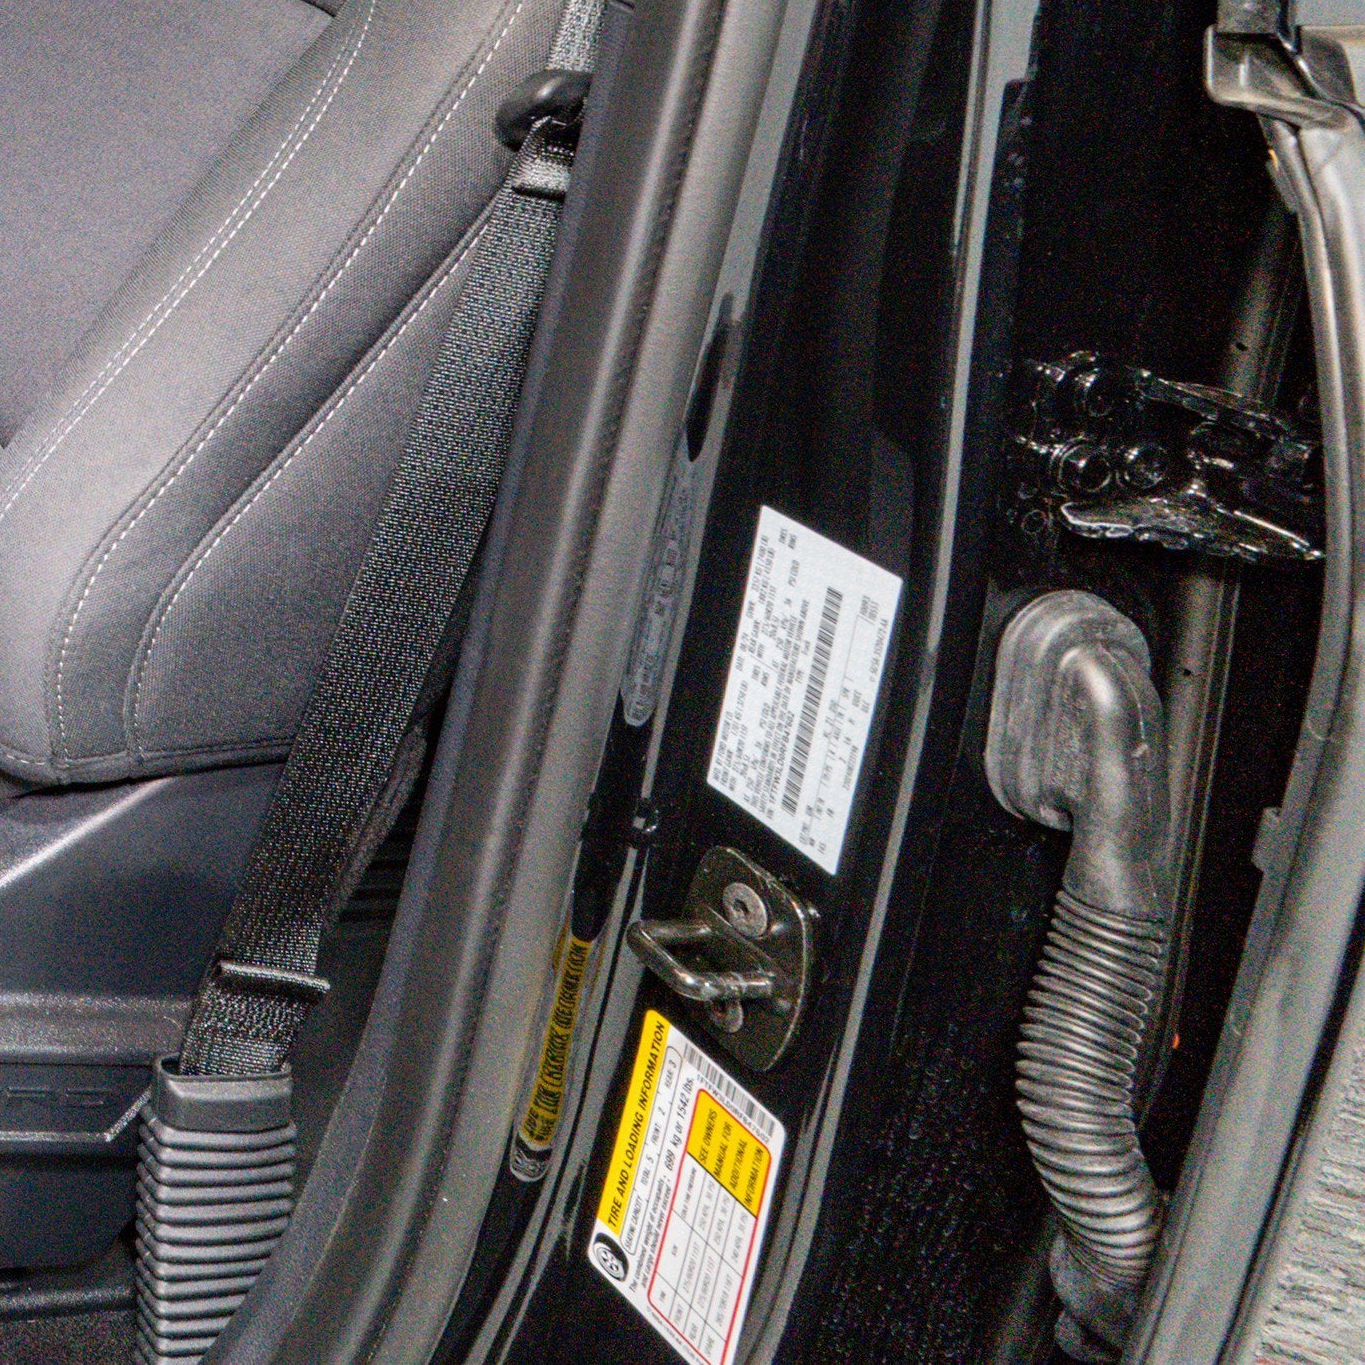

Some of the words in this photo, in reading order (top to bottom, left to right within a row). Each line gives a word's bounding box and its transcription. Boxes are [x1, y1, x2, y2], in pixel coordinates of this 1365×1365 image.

[675, 1091, 689, 1120] 1542
[607, 1195, 622, 1229] TIRE
[615, 1167, 629, 1198] AND
[622, 1109, 643, 1169] LOADING
[636, 1019, 665, 1111] INFORMATION
[669, 1131, 682, 1150] kg
[674, 1120, 683, 1135] or
[702, 1107, 717, 1147] OWNERS
[663, 1148, 676, 1172] 699
[697, 1144, 708, 1164] SEE
[712, 1139, 728, 1179] MANUAL
[721, 1120, 733, 1142] FOR
[728, 1135, 747, 1190] ADDITIONAL
[743, 1144, 764, 1208] INFORMATION
